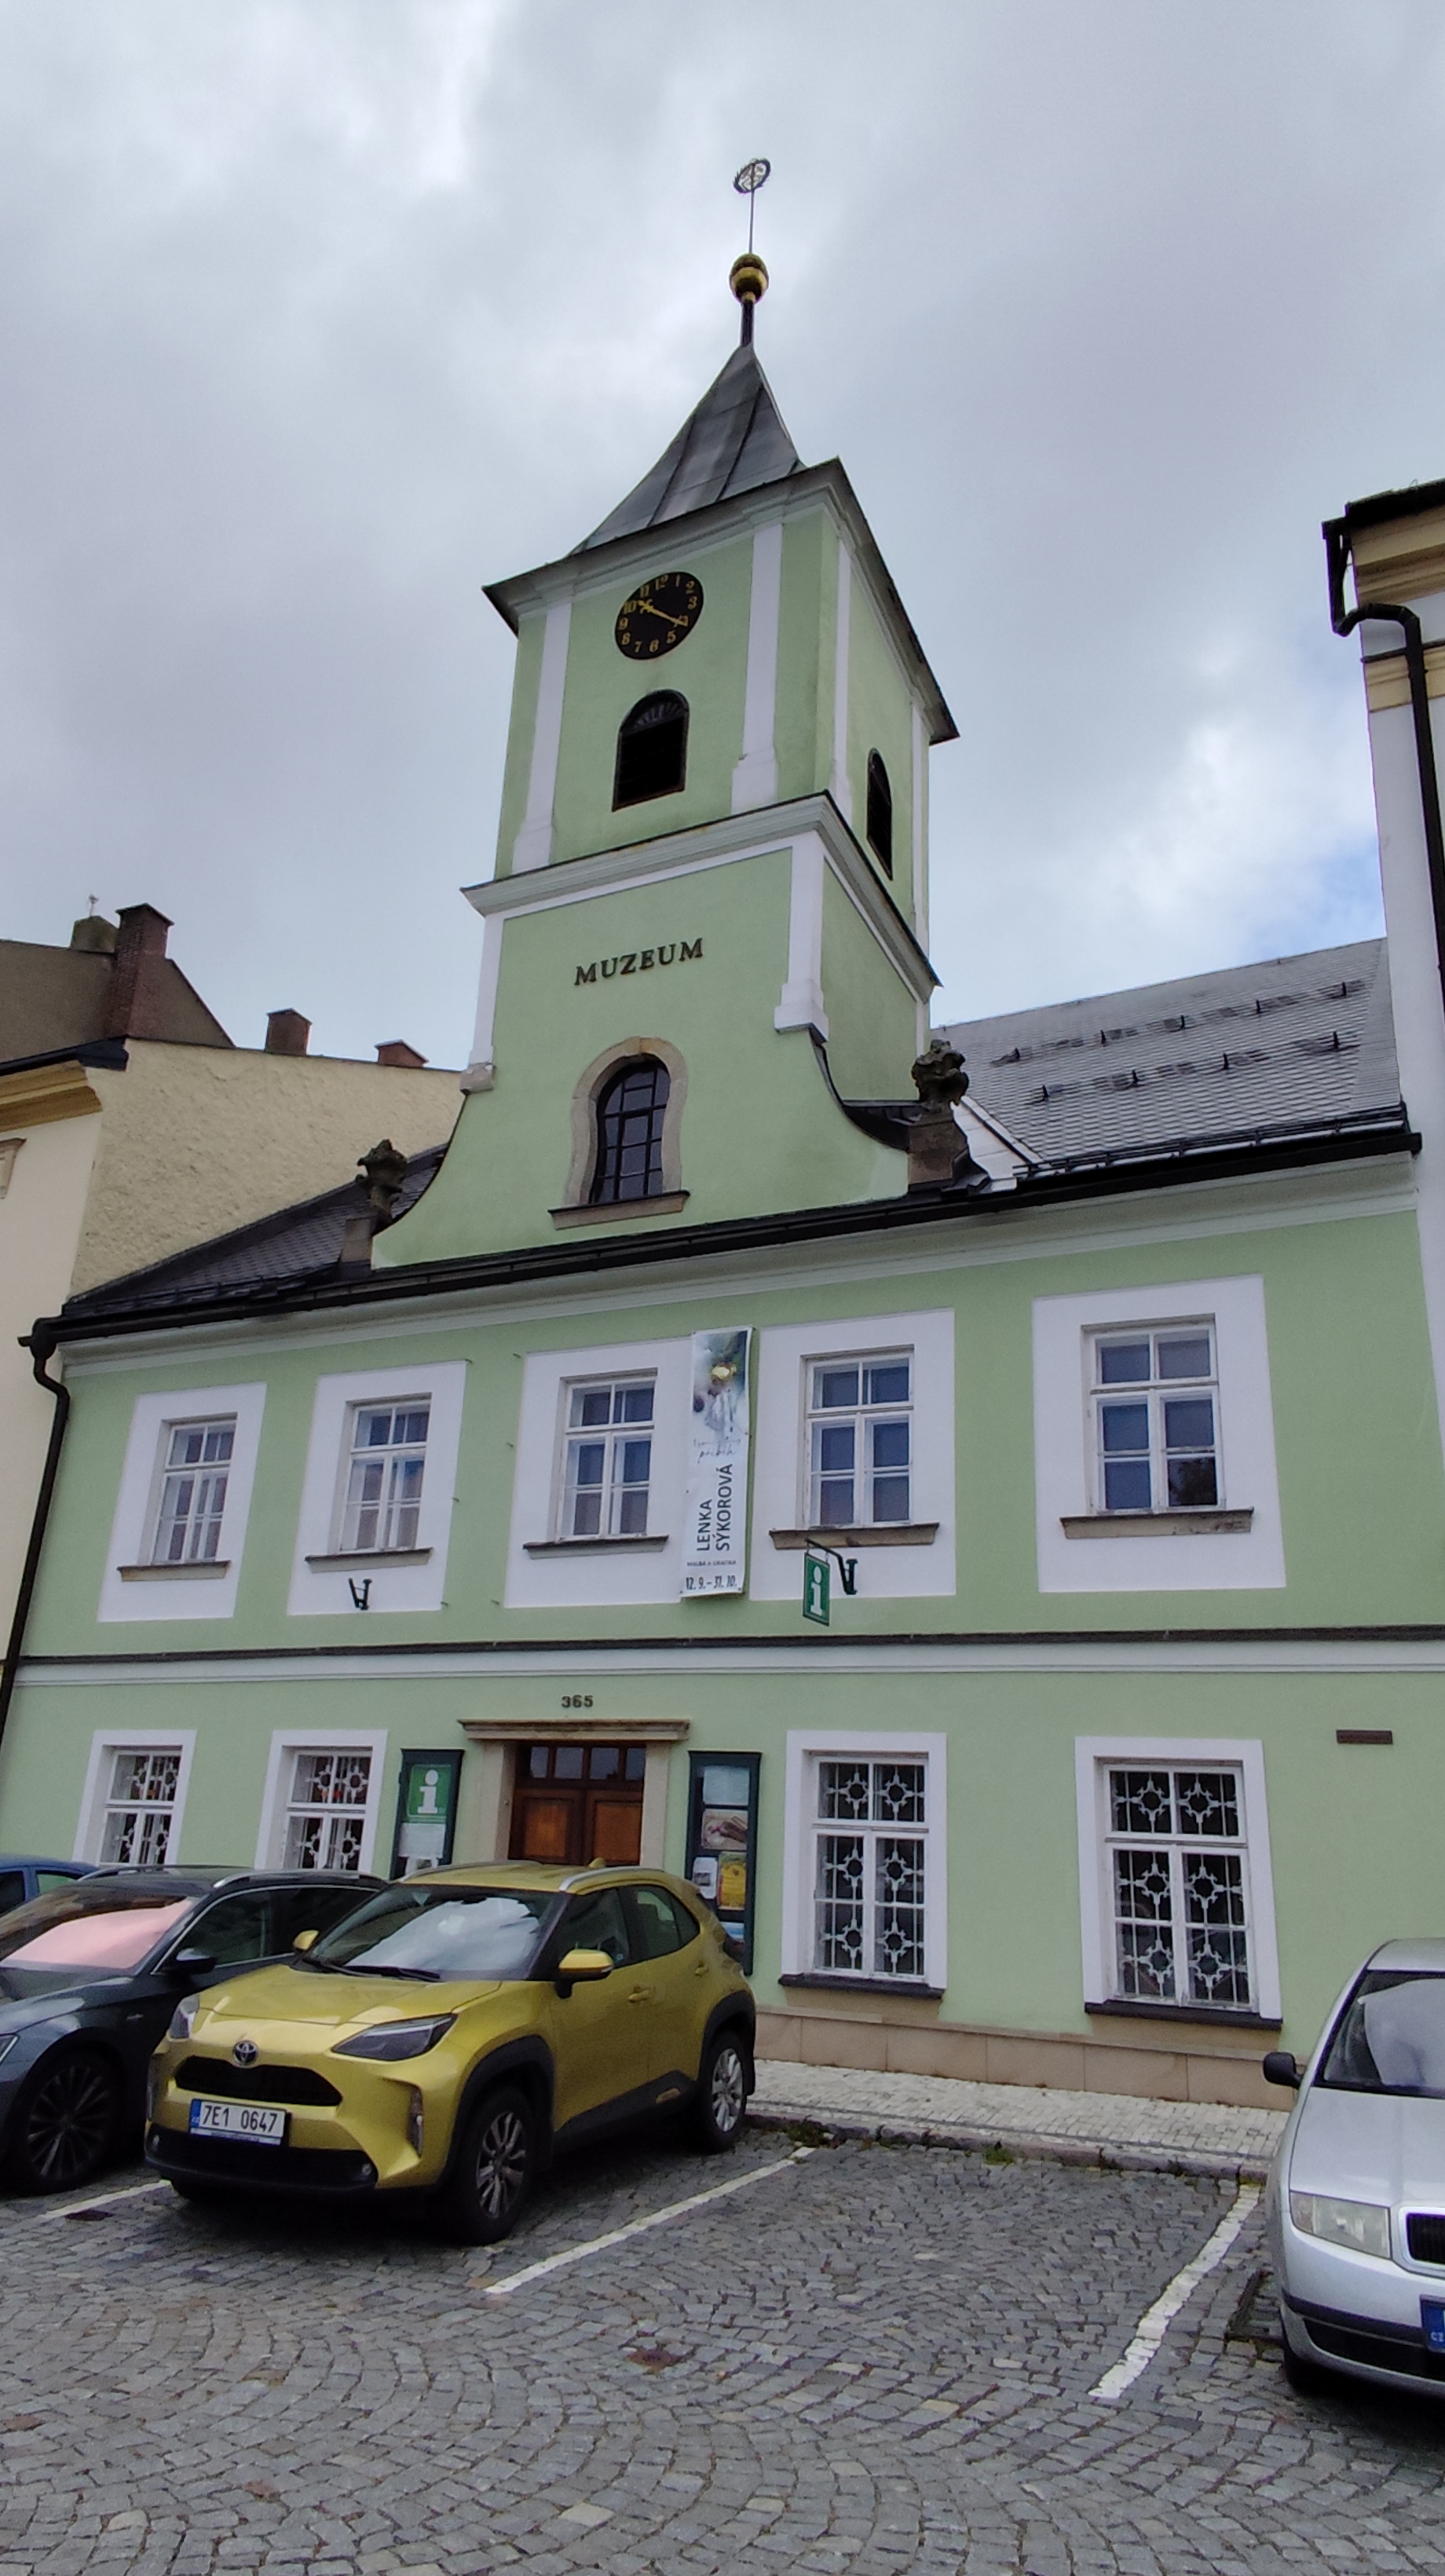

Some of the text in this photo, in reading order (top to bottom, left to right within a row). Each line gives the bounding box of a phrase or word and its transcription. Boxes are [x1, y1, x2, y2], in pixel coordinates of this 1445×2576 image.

[655, 574, 668, 591] 12
[675, 574, 681, 587] 1
[686, 580, 696, 595] 2
[640, 585, 650, 597] 11
[623, 600, 637, 614] 10
[688, 596, 698, 609] 3
[618, 617, 629, 631] 9
[622, 632, 631, 646] 8
[666, 630, 677, 644] 5
[635, 641, 642, 653] 7
[649, 639, 660, 653] 6
[574, 938, 703, 986] MUZEUM
[712, 1463, 733, 1551] SÝKOROVÁ
[696, 1498, 712, 1551] LENKA
[562, 1695, 593, 1708] 365
[203, 2105, 230, 2127] 7E1
[240, 2109, 278, 2133] 0647
[1430, 2331, 1444, 2343] CZ
